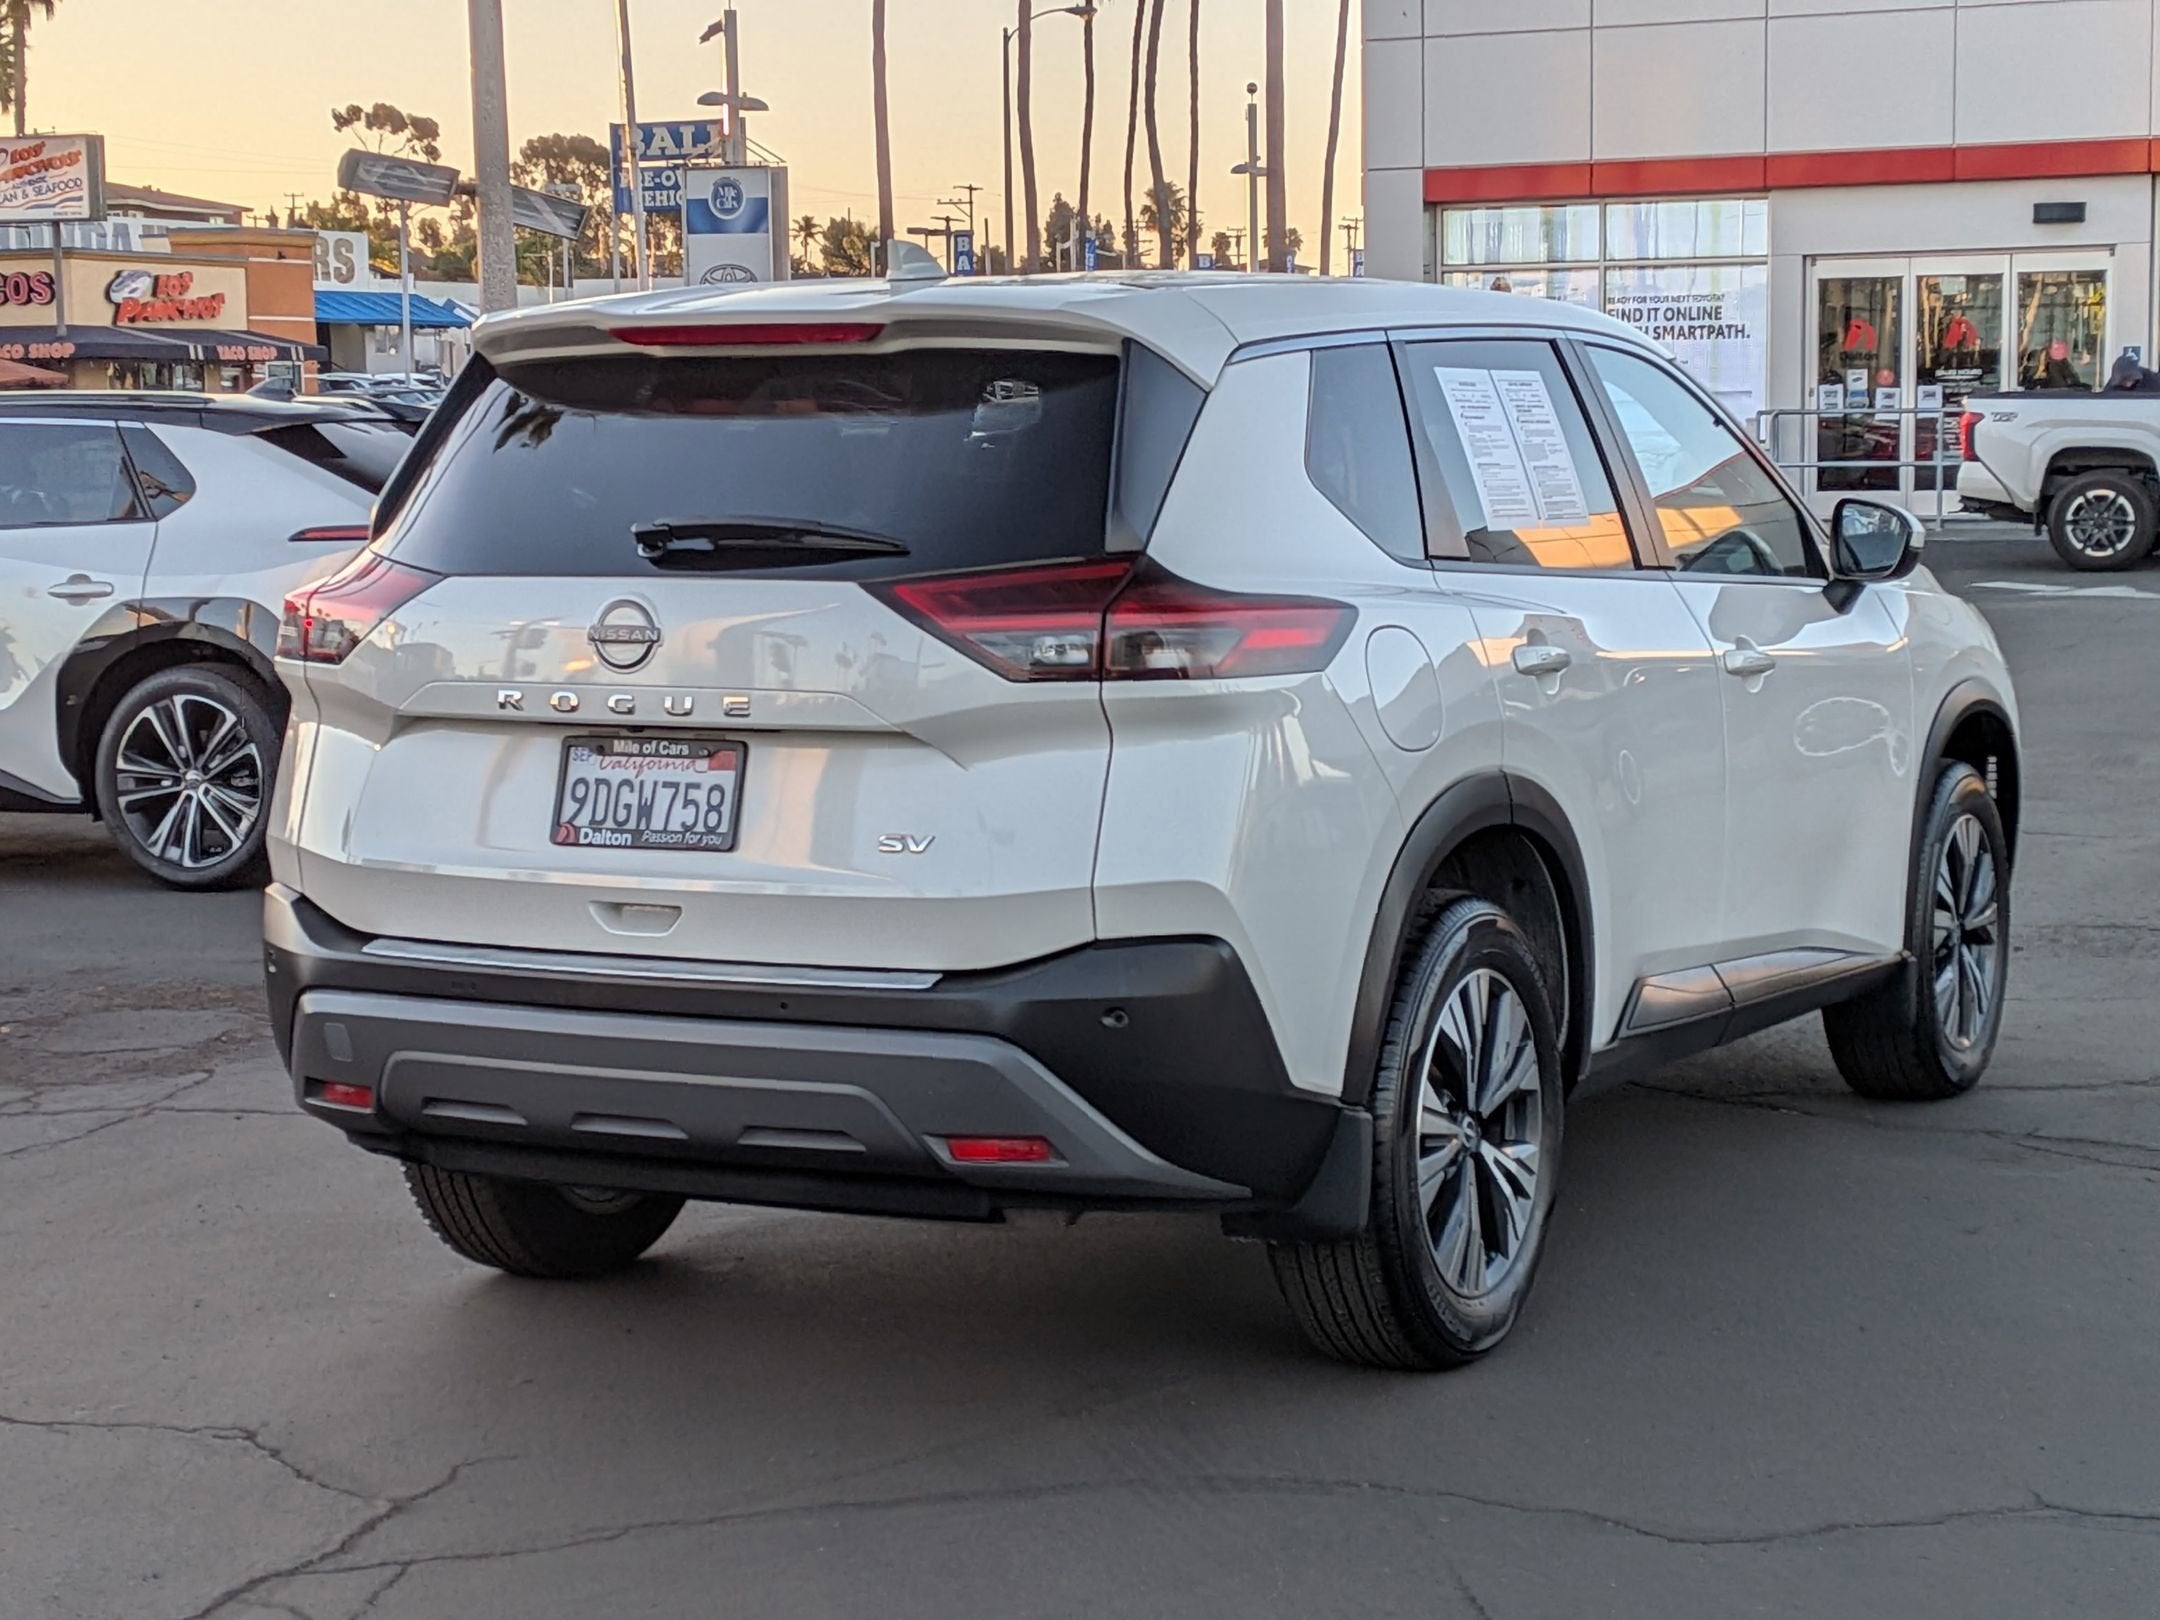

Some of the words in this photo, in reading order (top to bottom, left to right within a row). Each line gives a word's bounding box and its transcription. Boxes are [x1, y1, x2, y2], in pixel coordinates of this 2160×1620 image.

[0, 191, 18, 205] AN
[32, 178, 83, 197] SEAFOOD
[1608, 307, 1643, 323] FIND
[1647, 307, 1660, 322] IT
[1663, 305, 1722, 322] ONLINE
[1653, 324, 1750, 340] SMARTPATH.
[0, 343, 24, 359] CO
[247, 345, 278, 360] SHOP
[589, 628, 659, 641] NISSAN
[497, 690, 751, 717] ROGUE
[613, 739, 638, 753] Mile
[643, 740, 656, 753] of
[659, 742, 689, 755] Cars
[599, 756, 697, 778] California
[567, 777, 726, 832] 9DGW758
[579, 828, 632, 846] Dalton
[641, 830, 682, 844] Passion
[683, 831, 701, 844] for
[702, 834, 722, 846] you
[878, 833, 936, 853] SV
